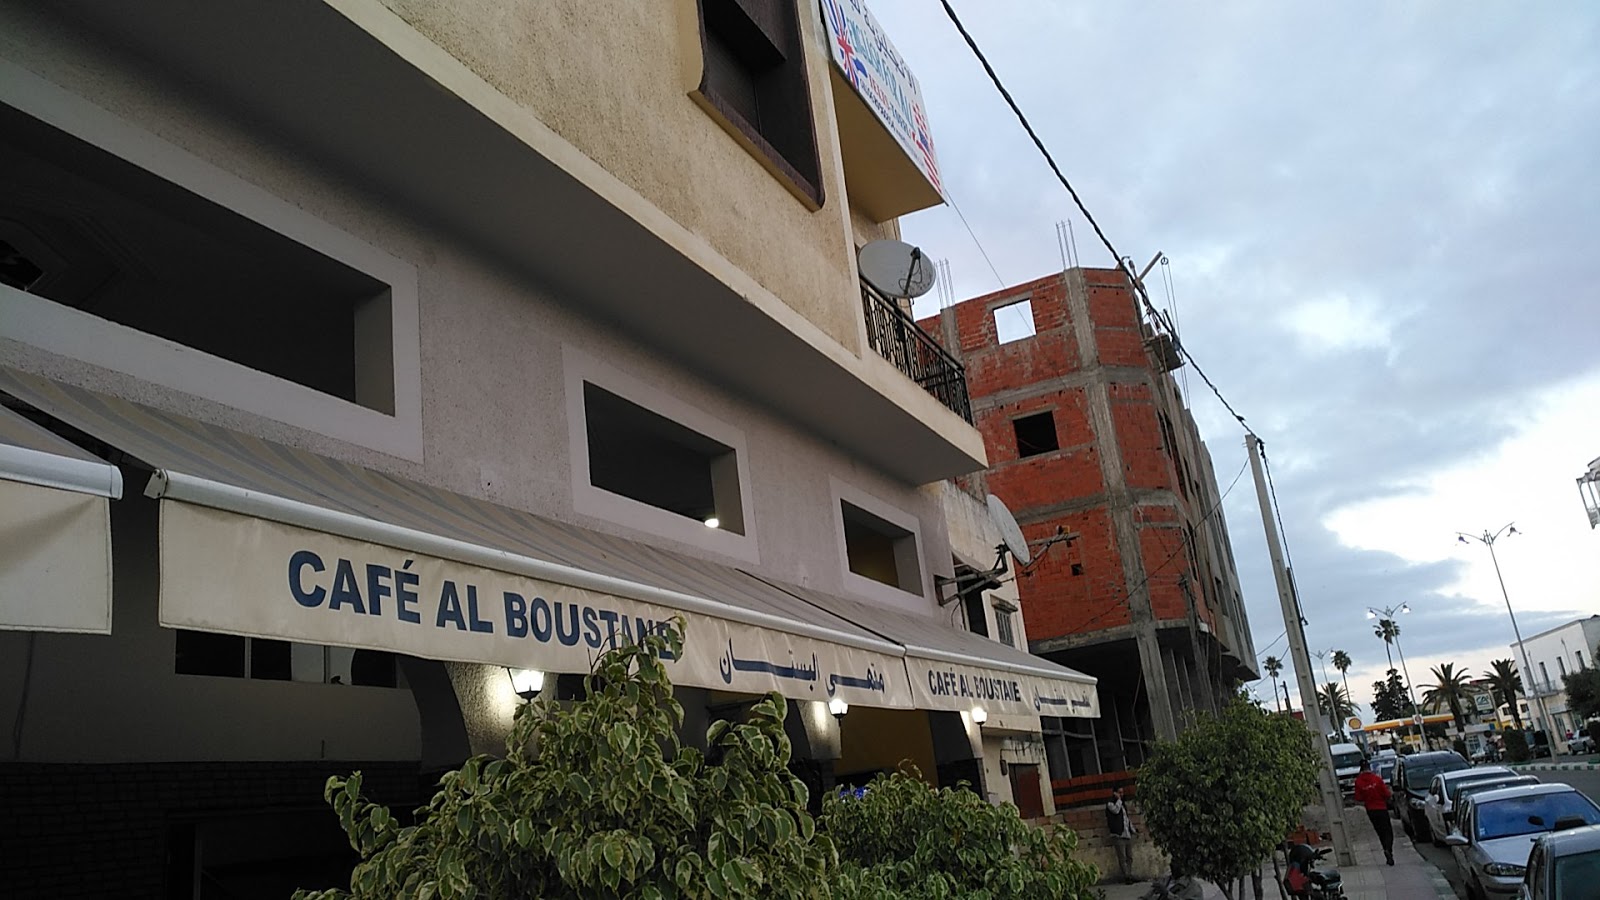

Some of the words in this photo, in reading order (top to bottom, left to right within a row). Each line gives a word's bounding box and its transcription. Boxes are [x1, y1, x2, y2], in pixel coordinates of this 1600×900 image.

[288, 550, 421, 624] CAFÉ
[436, 580, 494, 634] AL
[928, 667, 958, 697] CAFÉ
[959, 674, 974, 699] AL
